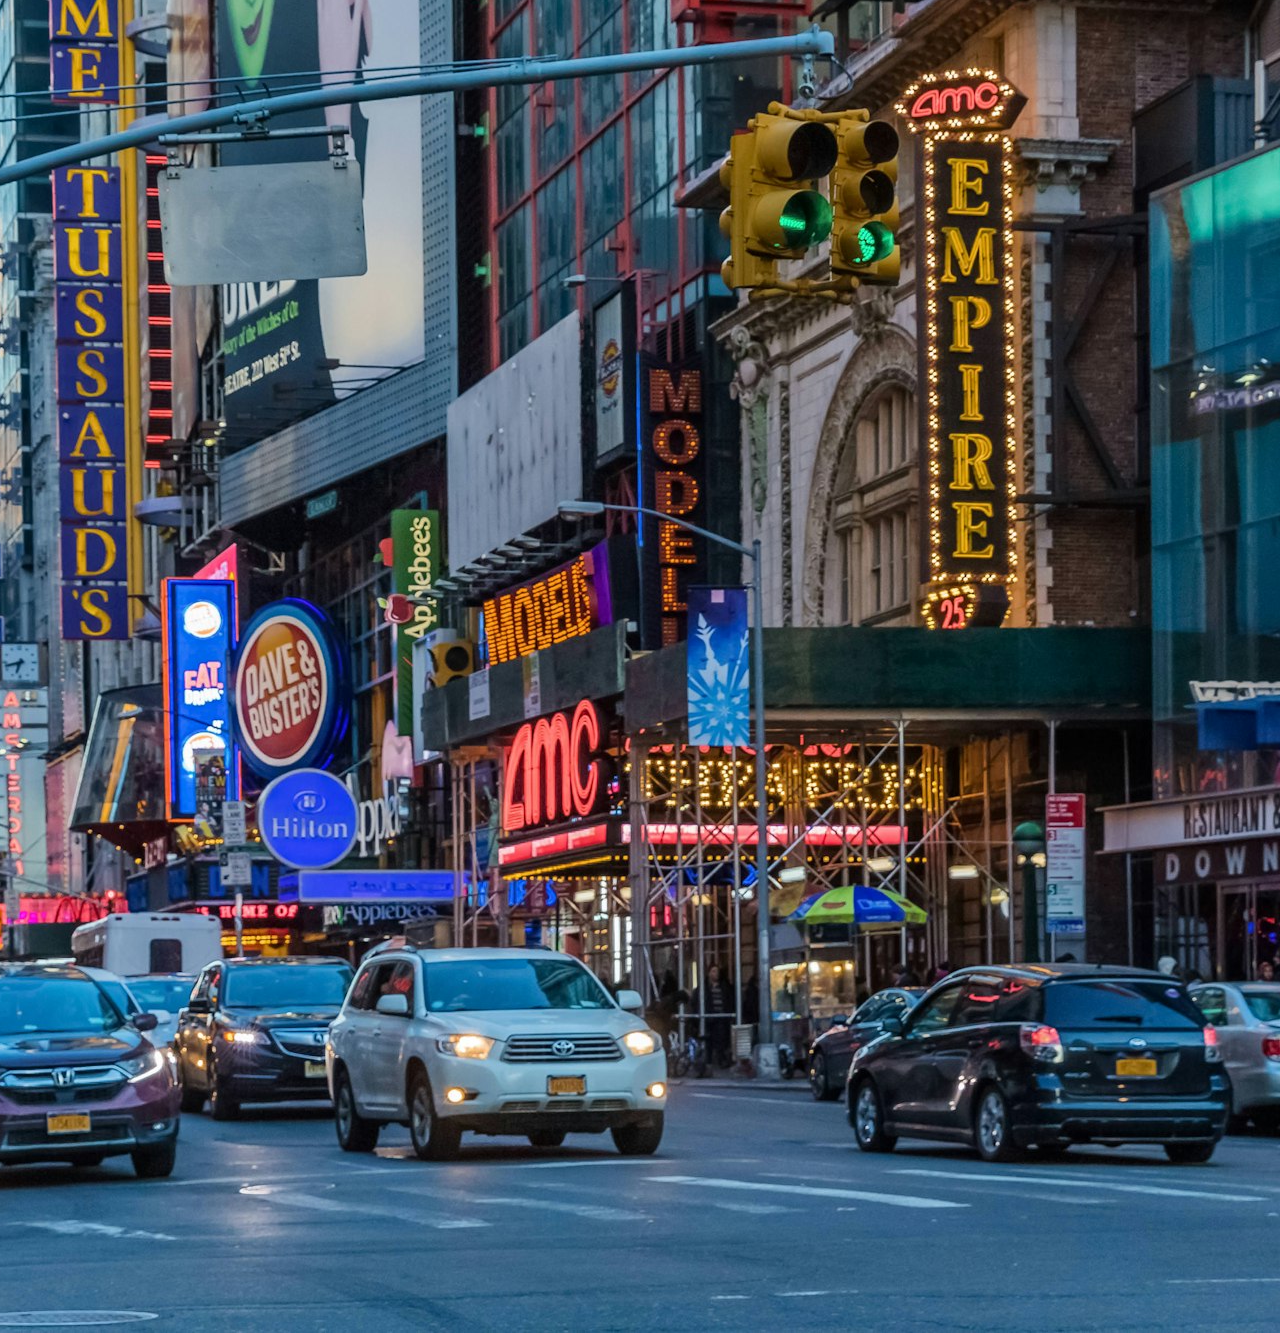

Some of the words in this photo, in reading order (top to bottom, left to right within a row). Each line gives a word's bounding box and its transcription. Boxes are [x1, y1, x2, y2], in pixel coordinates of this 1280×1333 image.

[246, 323, 257, 344] the
[256, 311, 282, 337] Witches
[282, 300, 289, 325] of
[263, 354, 280, 375] West
[940, 157, 999, 559] EMPIRE
[64, 168, 117, 638] TUSSAUD'S
[940, 596, 965, 629] 25
[245, 642, 299, 707] DAVE
[296, 639, 317, 677] &
[248, 676, 320, 741] BUSTER'S
[271, 817, 349, 840] Hilton
[1183, 794, 1268, 841] RESTAURANT
[274, 904, 298, 918] OF
